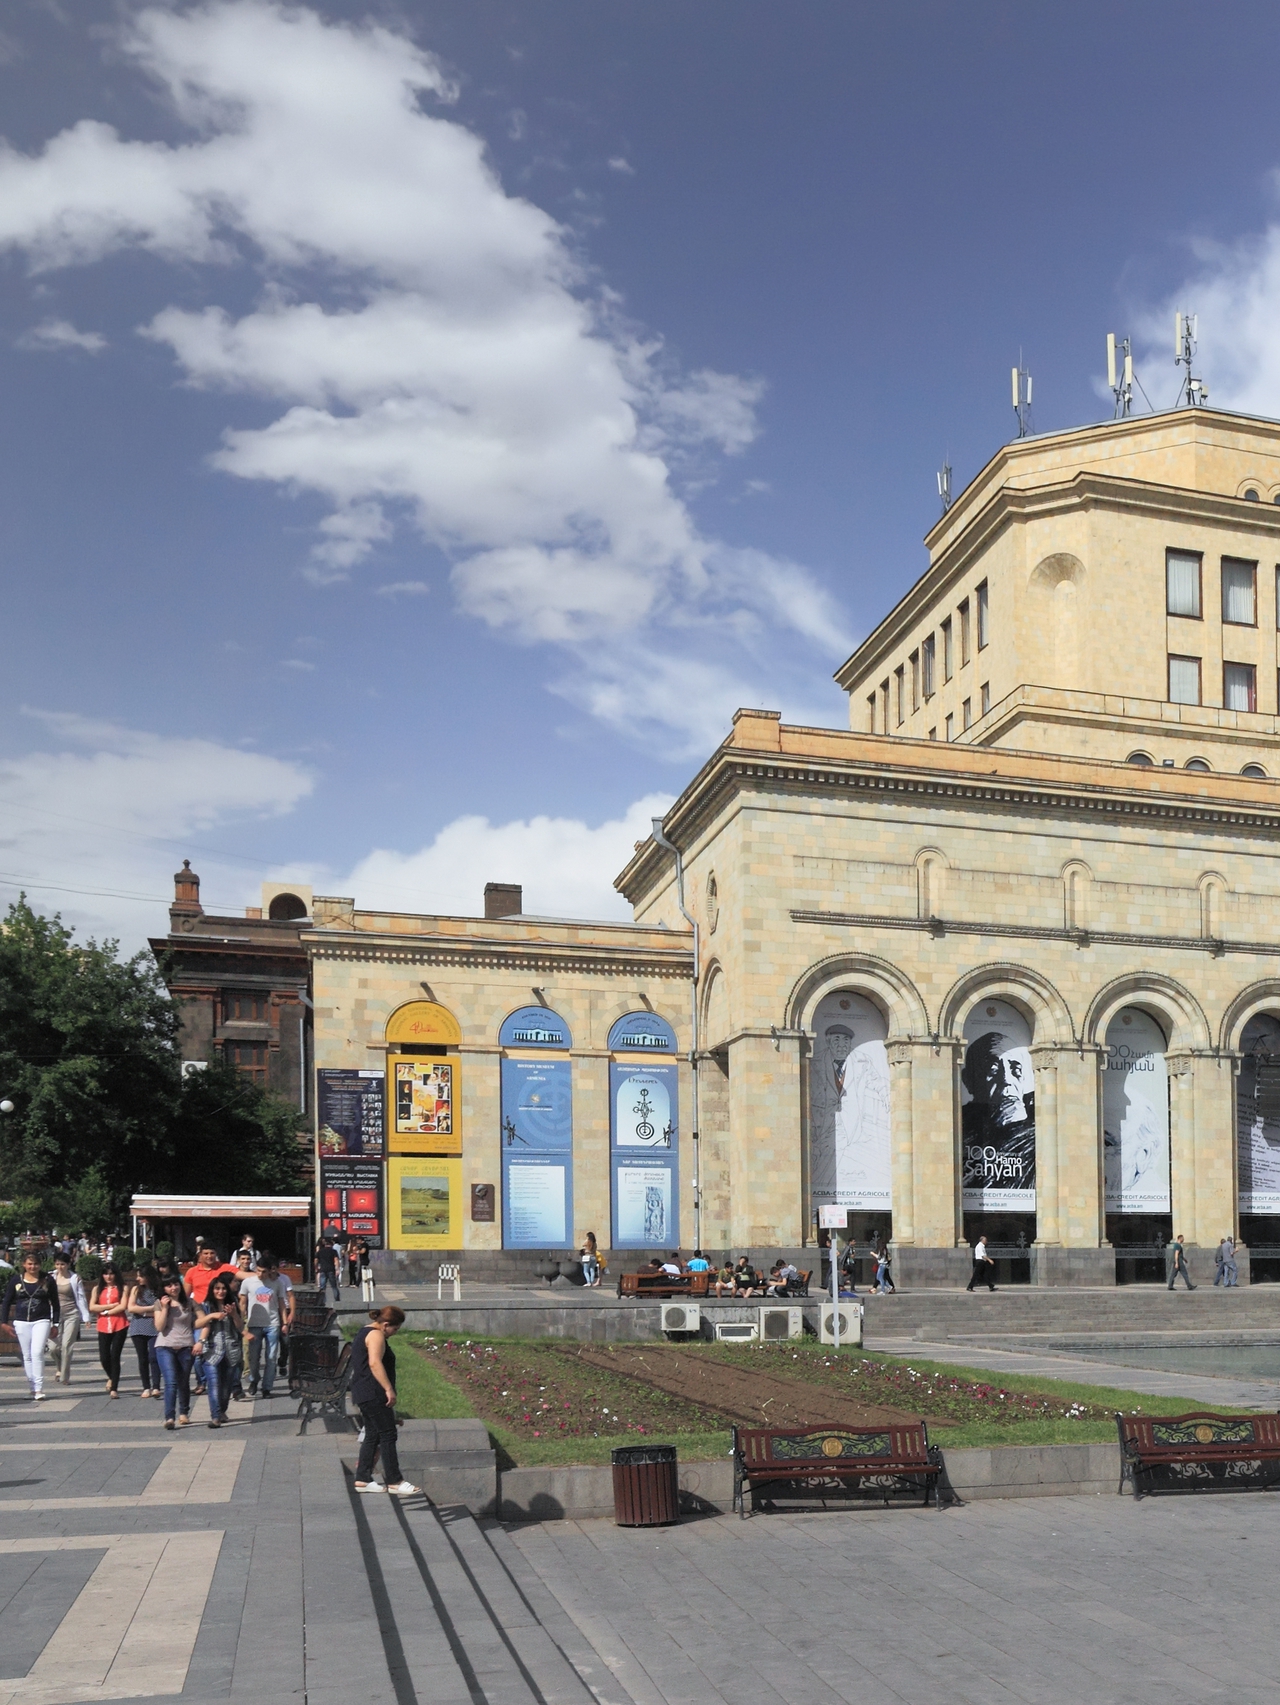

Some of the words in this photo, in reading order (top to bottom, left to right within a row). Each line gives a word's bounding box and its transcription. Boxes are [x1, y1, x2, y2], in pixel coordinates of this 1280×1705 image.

[1107, 1044, 1130, 1058] 00
[965, 1145, 996, 1160] 100
[996, 1156, 1022, 1165] Hamo
[965, 1159, 1023, 1181] Sahyan
